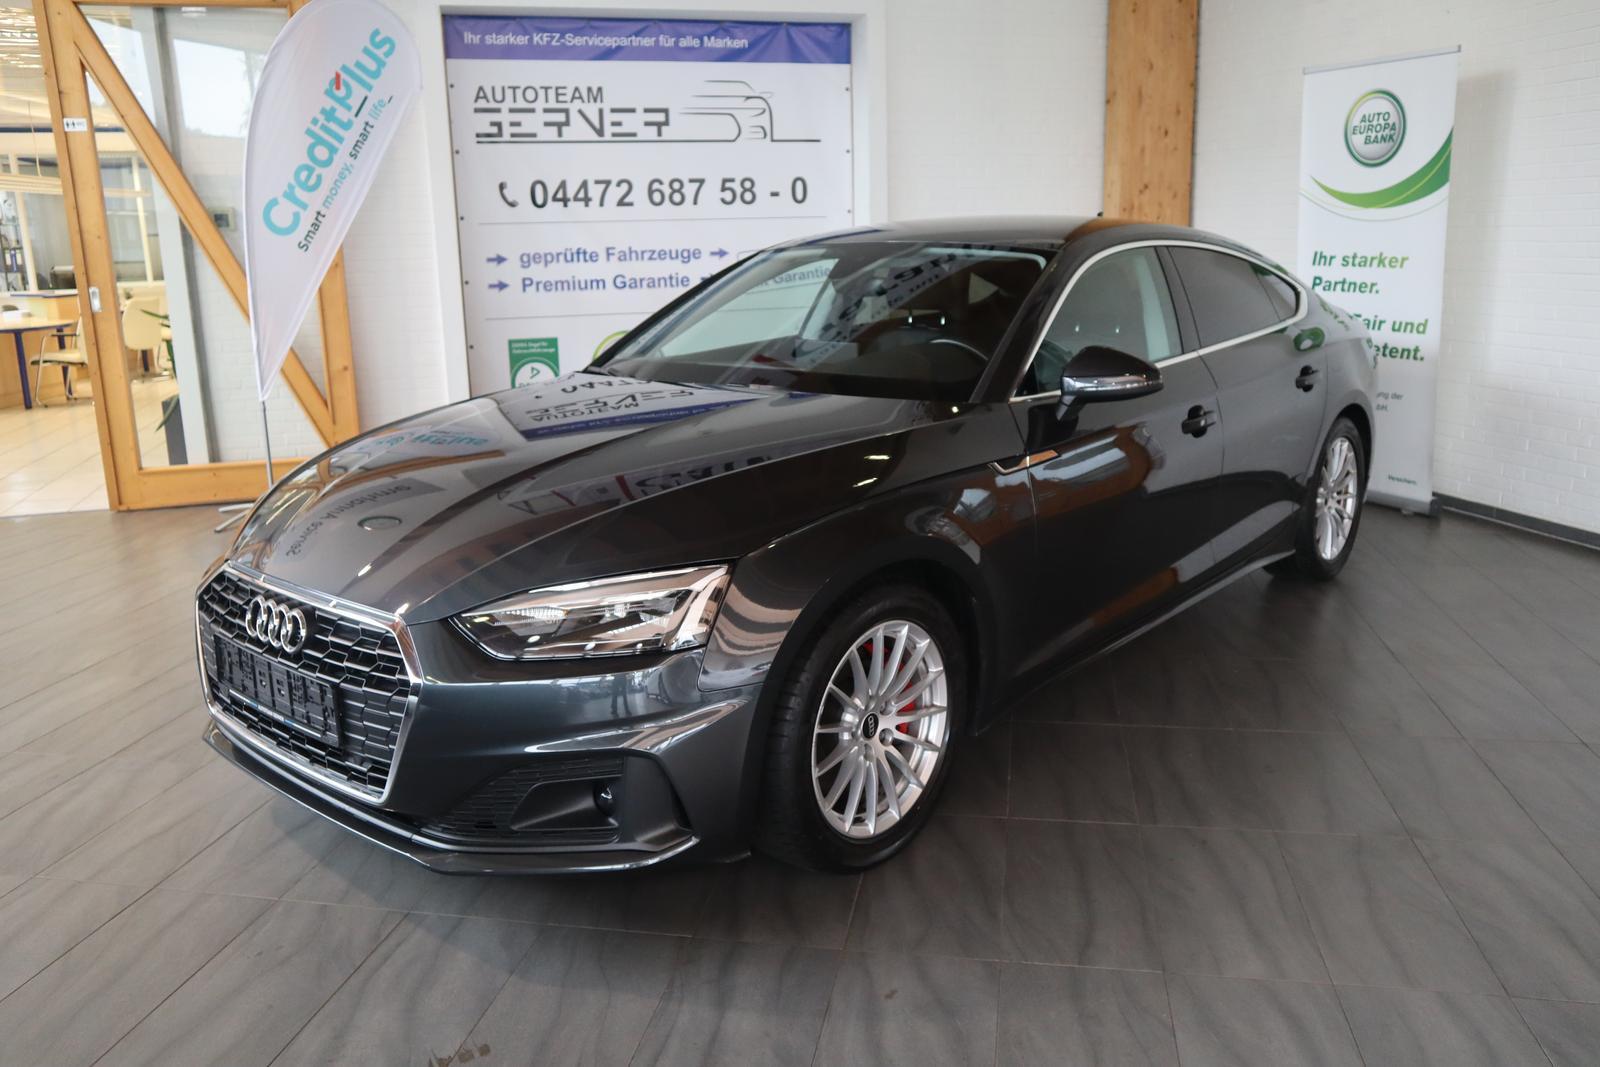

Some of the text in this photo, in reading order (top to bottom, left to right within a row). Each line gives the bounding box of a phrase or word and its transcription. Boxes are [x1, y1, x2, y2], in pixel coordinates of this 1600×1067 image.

[463, 31, 749, 48] Ihr starker KFZ-Servicepartner für alle Marken
[473, 86, 604, 104] AUTOTEAM
[1360, 111, 1391, 124] AUTO
[262, 28, 396, 237] CreditPlus
[1351, 121, 1398, 136] EUROPA
[1363, 132, 1397, 145] BANK
[297, 209, 327, 252] Smart
[323, 161, 356, 209] money,
[349, 121, 375, 160] smart
[529, 178, 635, 208] 04472
[646, 178, 706, 206] 687
[719, 177, 757, 205] 58
[791, 176, 809, 204] 0
[519, 244, 703, 268] geprüfte Fahrzeuge
[1312, 251, 1409, 269] Ihr starker
[521, 273, 691, 293] Premium Garantie
[1311, 276, 1380, 295] Partner.
[1353, 313, 1429, 334] air und
